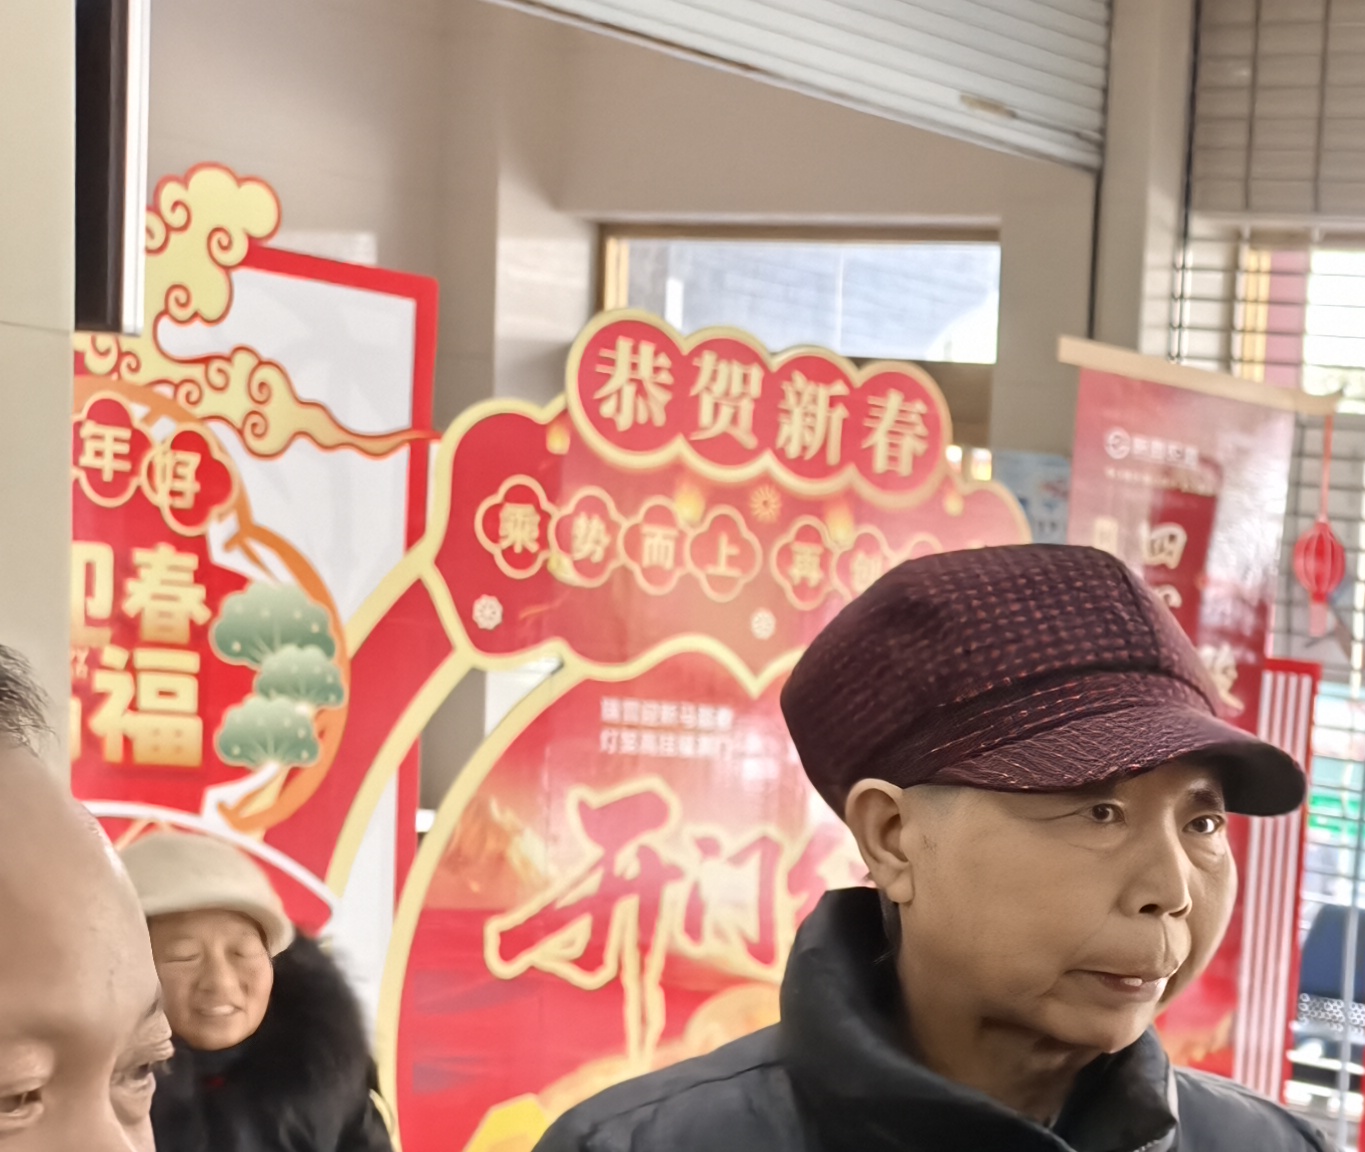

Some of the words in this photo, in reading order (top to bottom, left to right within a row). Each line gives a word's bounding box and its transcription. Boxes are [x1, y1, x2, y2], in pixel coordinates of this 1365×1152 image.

[79, 421, 201, 509] 年好
[594, 335, 930, 476] 恭贺新春
[499, 502, 742, 578] 乘势而上
[70, 644, 204, 767] 福
[484, 774, 850, 1066] 开门
